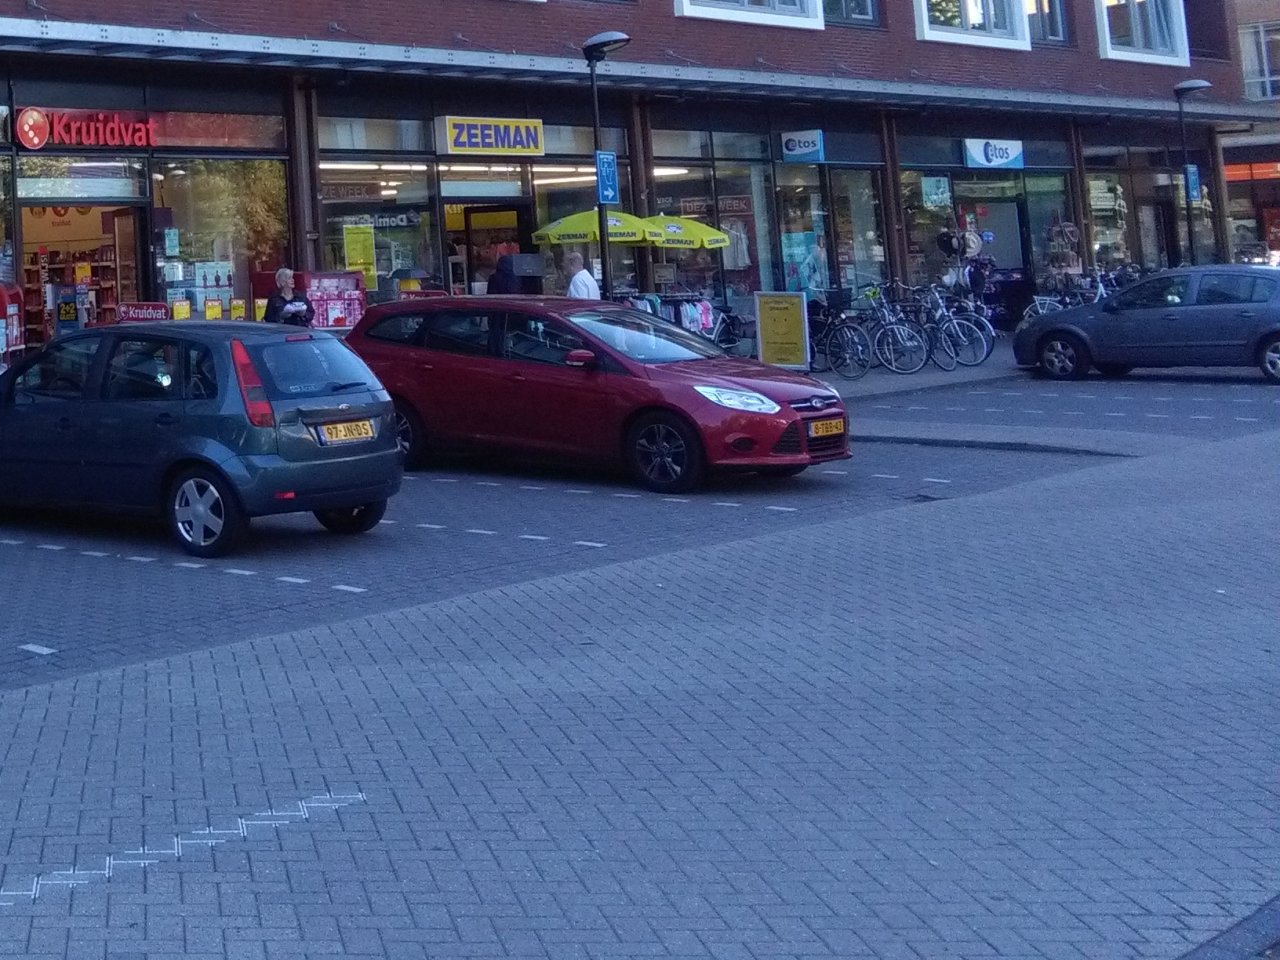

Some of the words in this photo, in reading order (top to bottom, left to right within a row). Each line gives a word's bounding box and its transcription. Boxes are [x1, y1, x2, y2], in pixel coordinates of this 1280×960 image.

[52, 113, 157, 147] Kruidvat
[452, 123, 539, 149] ZEEMAN
[784, 138, 817, 152] etos
[983, 141, 1010, 164] etos
[686, 202, 707, 212] DEZ
[129, 306, 166, 319] Kruidvat
[326, 423, 369, 440] 97-JN-DS
